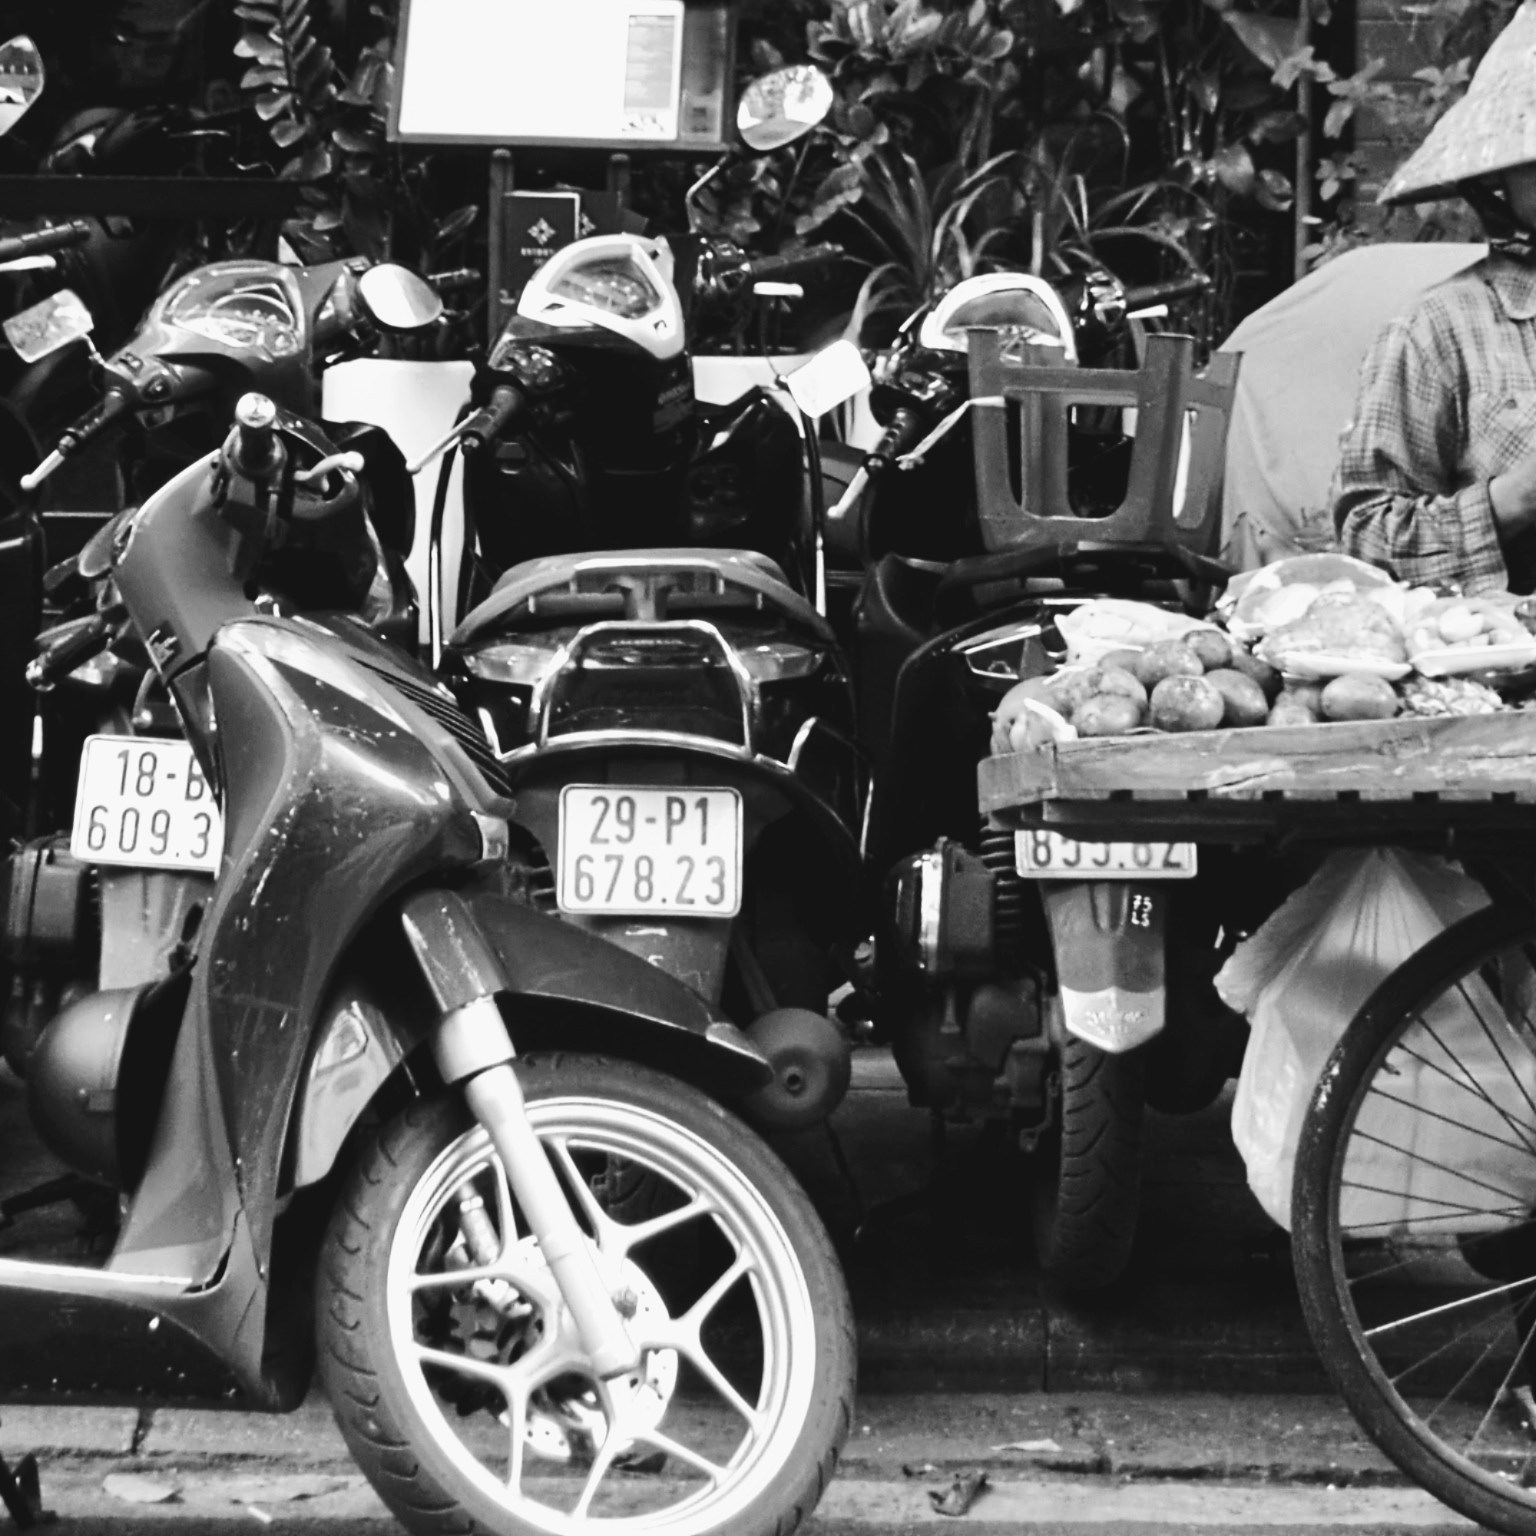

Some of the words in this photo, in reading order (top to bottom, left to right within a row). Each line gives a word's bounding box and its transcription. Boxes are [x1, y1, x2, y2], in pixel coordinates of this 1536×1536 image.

[117, 749, 214, 802] 18-B
[88, 804, 212, 859] 609.3
[589, 795, 709, 846] 29-P1
[575, 853, 726, 906] 678.23
